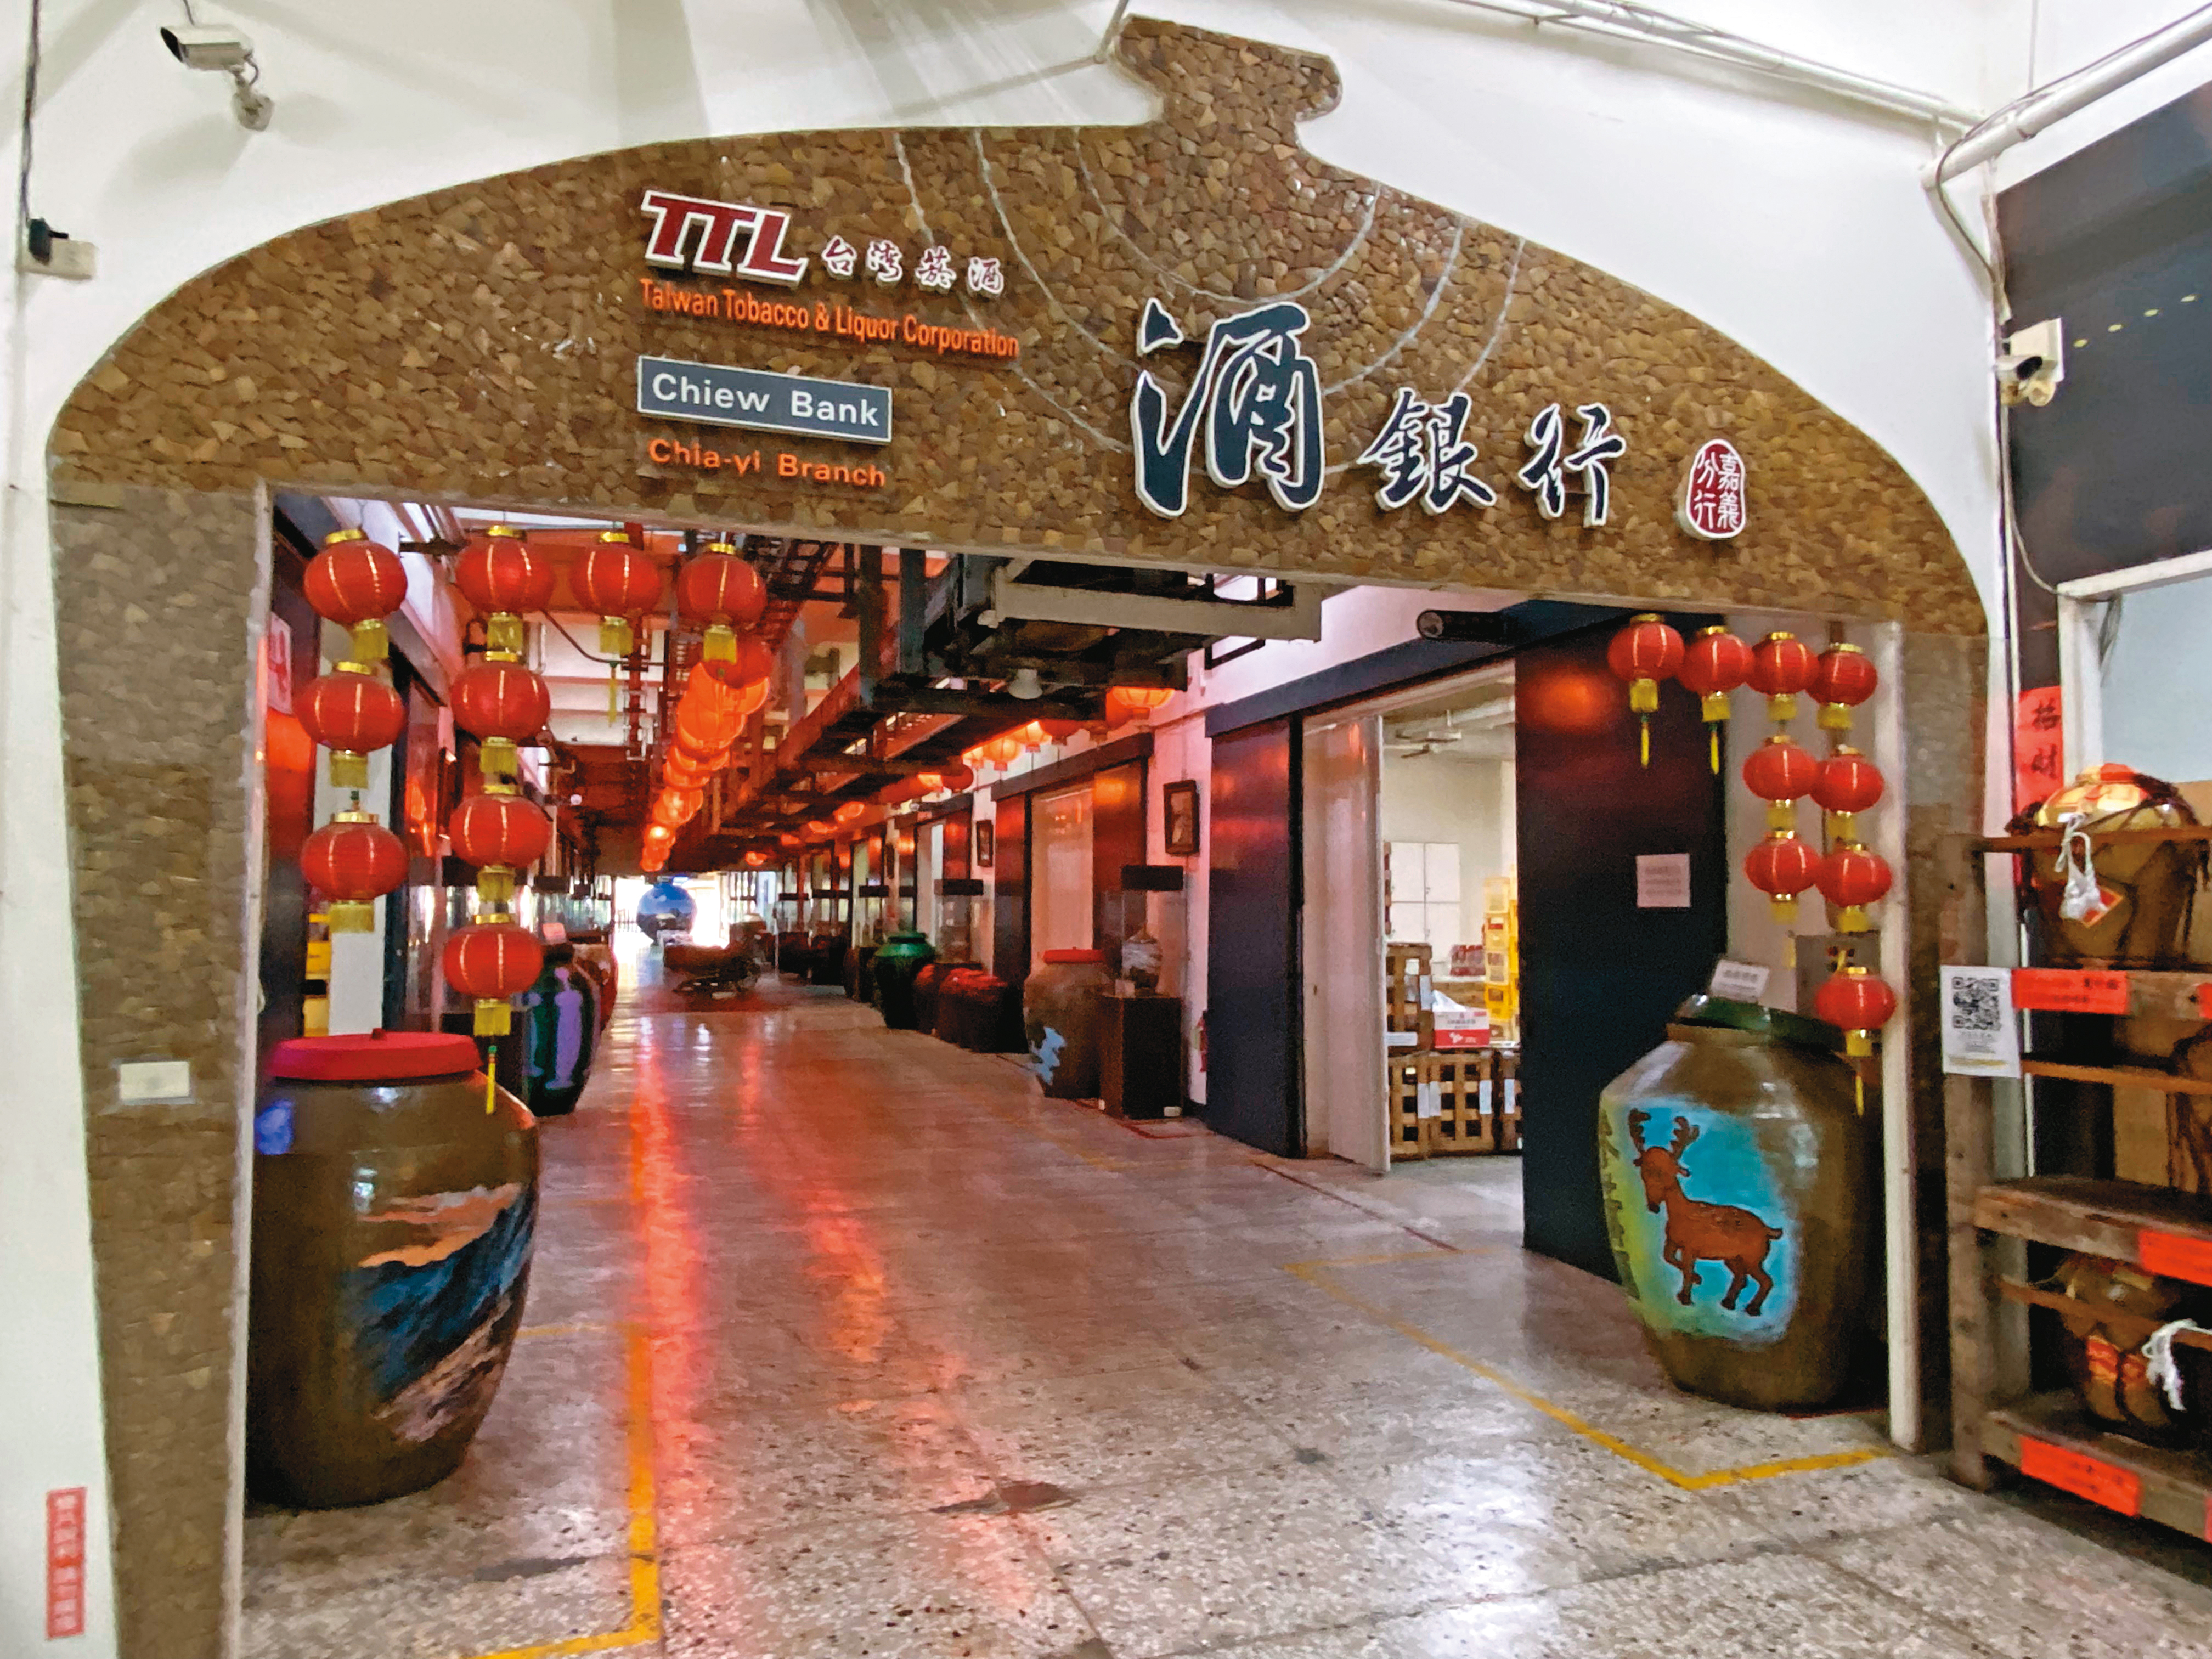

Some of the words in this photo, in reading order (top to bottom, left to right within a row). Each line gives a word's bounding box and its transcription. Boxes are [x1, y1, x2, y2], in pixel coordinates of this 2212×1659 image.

[641, 190, 809, 286] TTL
[640, 277, 719, 318] Taiwan
[721, 288, 809, 329] Tobacco
[814, 301, 831, 332] &
[836, 304, 899, 343] Liquor
[902, 313, 1019, 357] Corporation
[651, 372, 770, 413] Chiew
[790, 389, 879, 428] Bank
[1132, 297, 1627, 529] 酒銀行
[647, 437, 762, 478] Chia-yi
[776, 452, 887, 488] Branch
[1717, 452, 1740, 531] 嘉義
